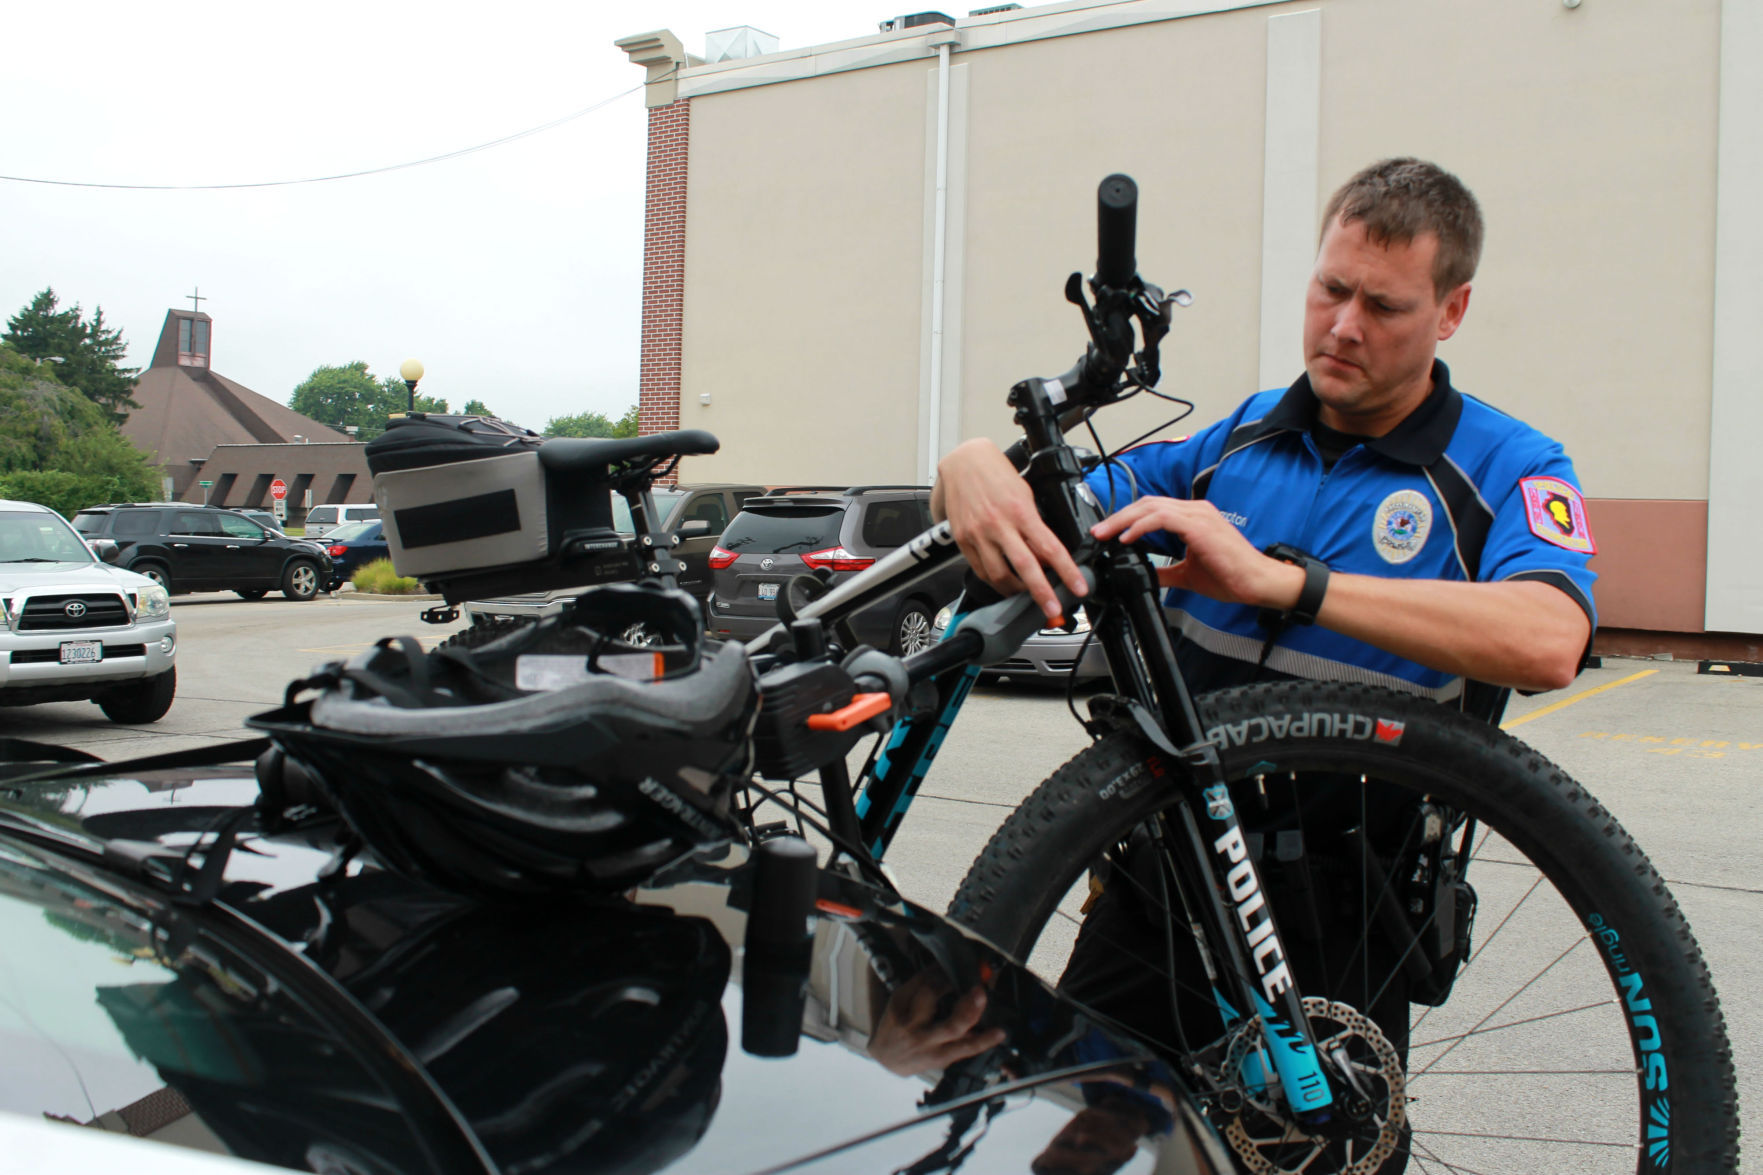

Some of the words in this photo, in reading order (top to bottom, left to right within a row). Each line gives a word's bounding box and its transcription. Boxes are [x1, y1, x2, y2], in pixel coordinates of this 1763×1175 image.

[272, 485, 287, 493] STOP
[1214, 825, 1293, 1004] POLICE
[1297, 1071, 1324, 1102] 110
